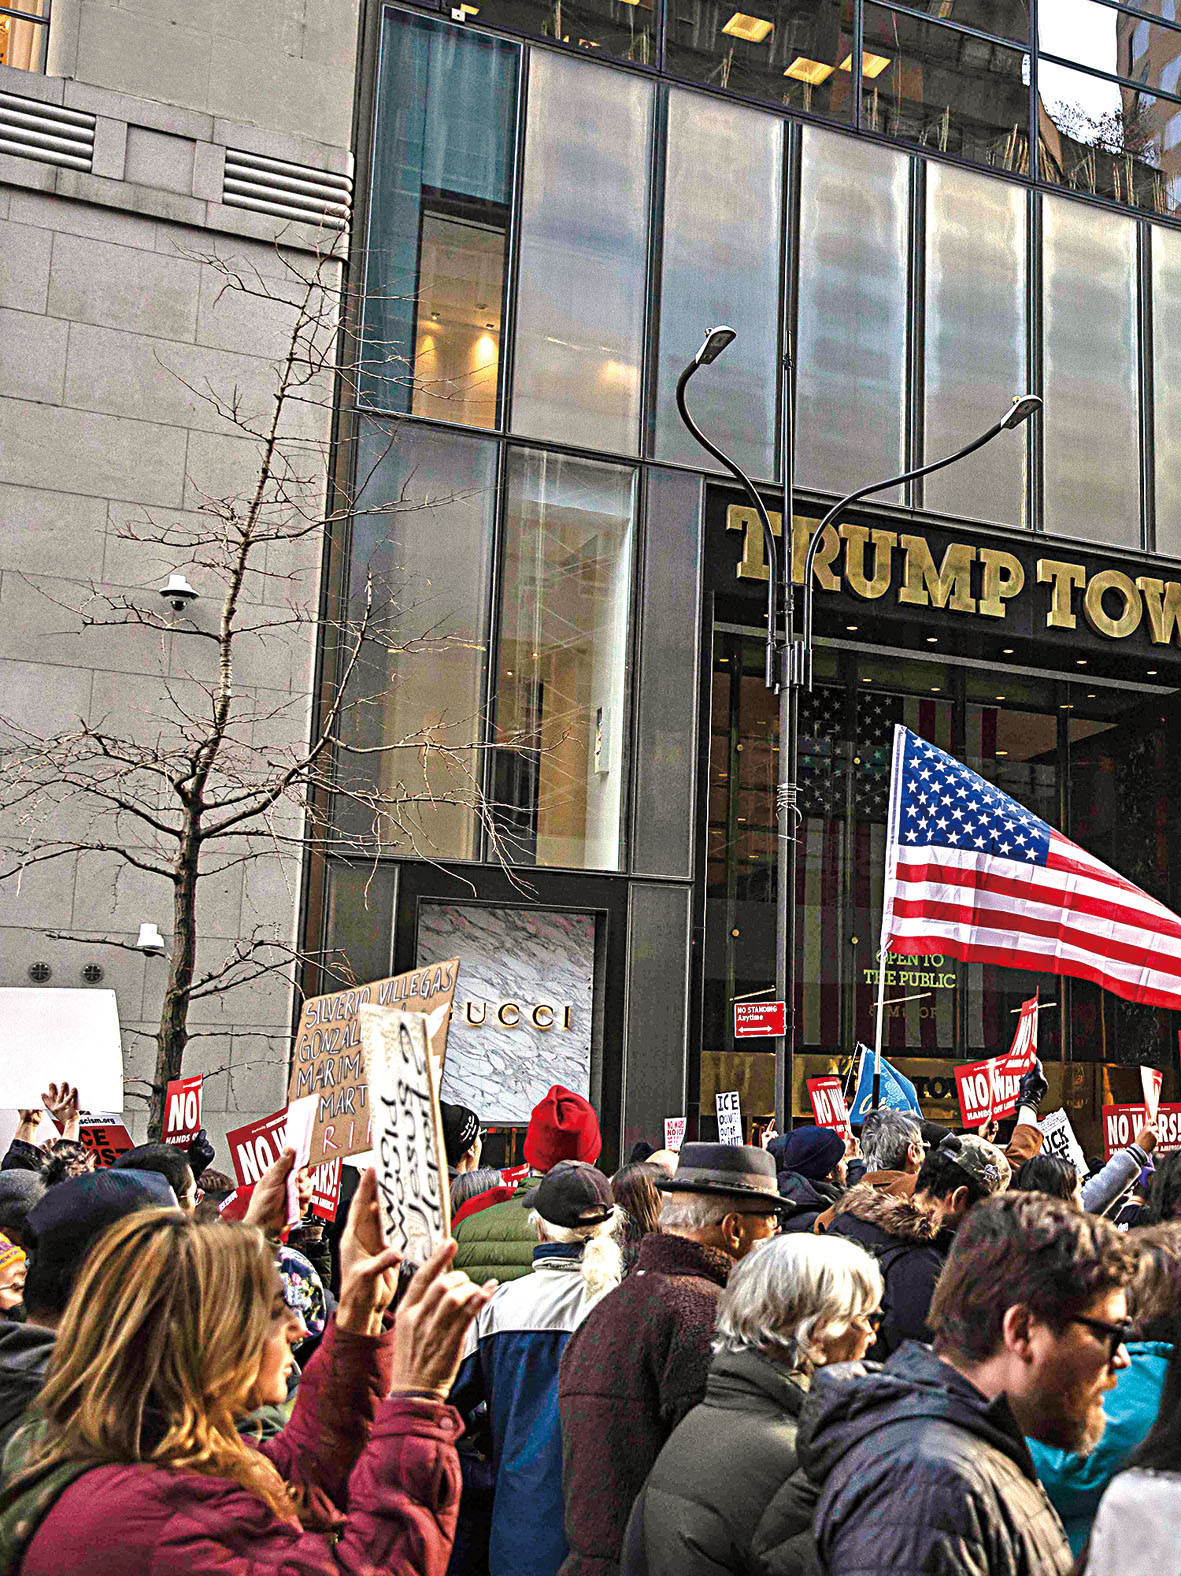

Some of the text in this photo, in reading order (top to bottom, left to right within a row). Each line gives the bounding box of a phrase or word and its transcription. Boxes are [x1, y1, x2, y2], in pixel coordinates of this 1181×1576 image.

[725, 504, 1025, 618] TRUMP
[923, 953, 944, 967] TO
[378, 962, 454, 1005] VILLEGAS
[899, 971, 956, 988] PUBLIC
[449, 1001, 571, 1030] UCCI
[737, 1005, 778, 1014] NO STANDING
[737, 1014, 764, 1023] Anytime
[297, 1051, 365, 1098] MARIM
[717, 1093, 739, 1112] ICE
[812, 1089, 833, 1125] NO
[961, 1073, 989, 1110] NO
[79, 1116, 116, 1125] scism.org
[168, 1090, 198, 1132] NO
[966, 1108, 992, 1121] HANDS
[80, 1129, 109, 1147] CE
[1042, 1125, 1070, 1155] UCK
[1107, 1114, 1130, 1146] NO
[236, 1135, 275, 1185] NO
[381, 1096, 409, 1251] would
[398, 1079, 433, 1261] Jesus
[311, 1156, 340, 1198] ARS!
